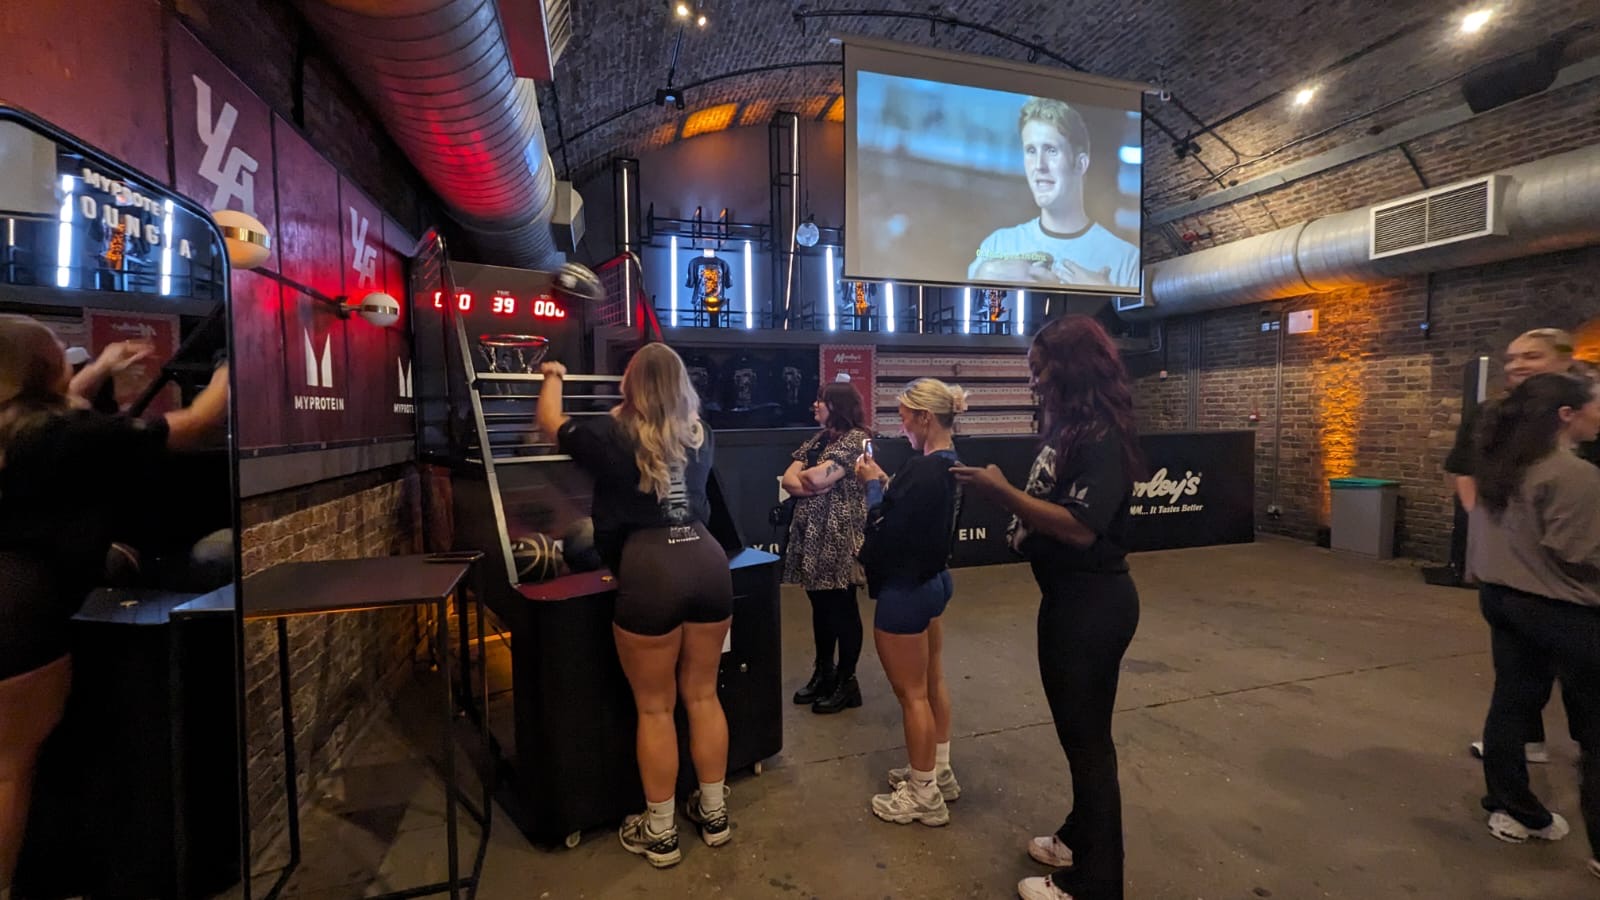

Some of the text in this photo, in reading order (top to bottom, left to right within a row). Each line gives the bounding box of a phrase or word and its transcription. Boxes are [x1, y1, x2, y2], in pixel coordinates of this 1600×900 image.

[493, 297, 515, 313] 39
[294, 396, 344, 410] MYPROTEIN
[1158, 505, 1180, 514] Tastes
[1181, 504, 1203, 512] Better
